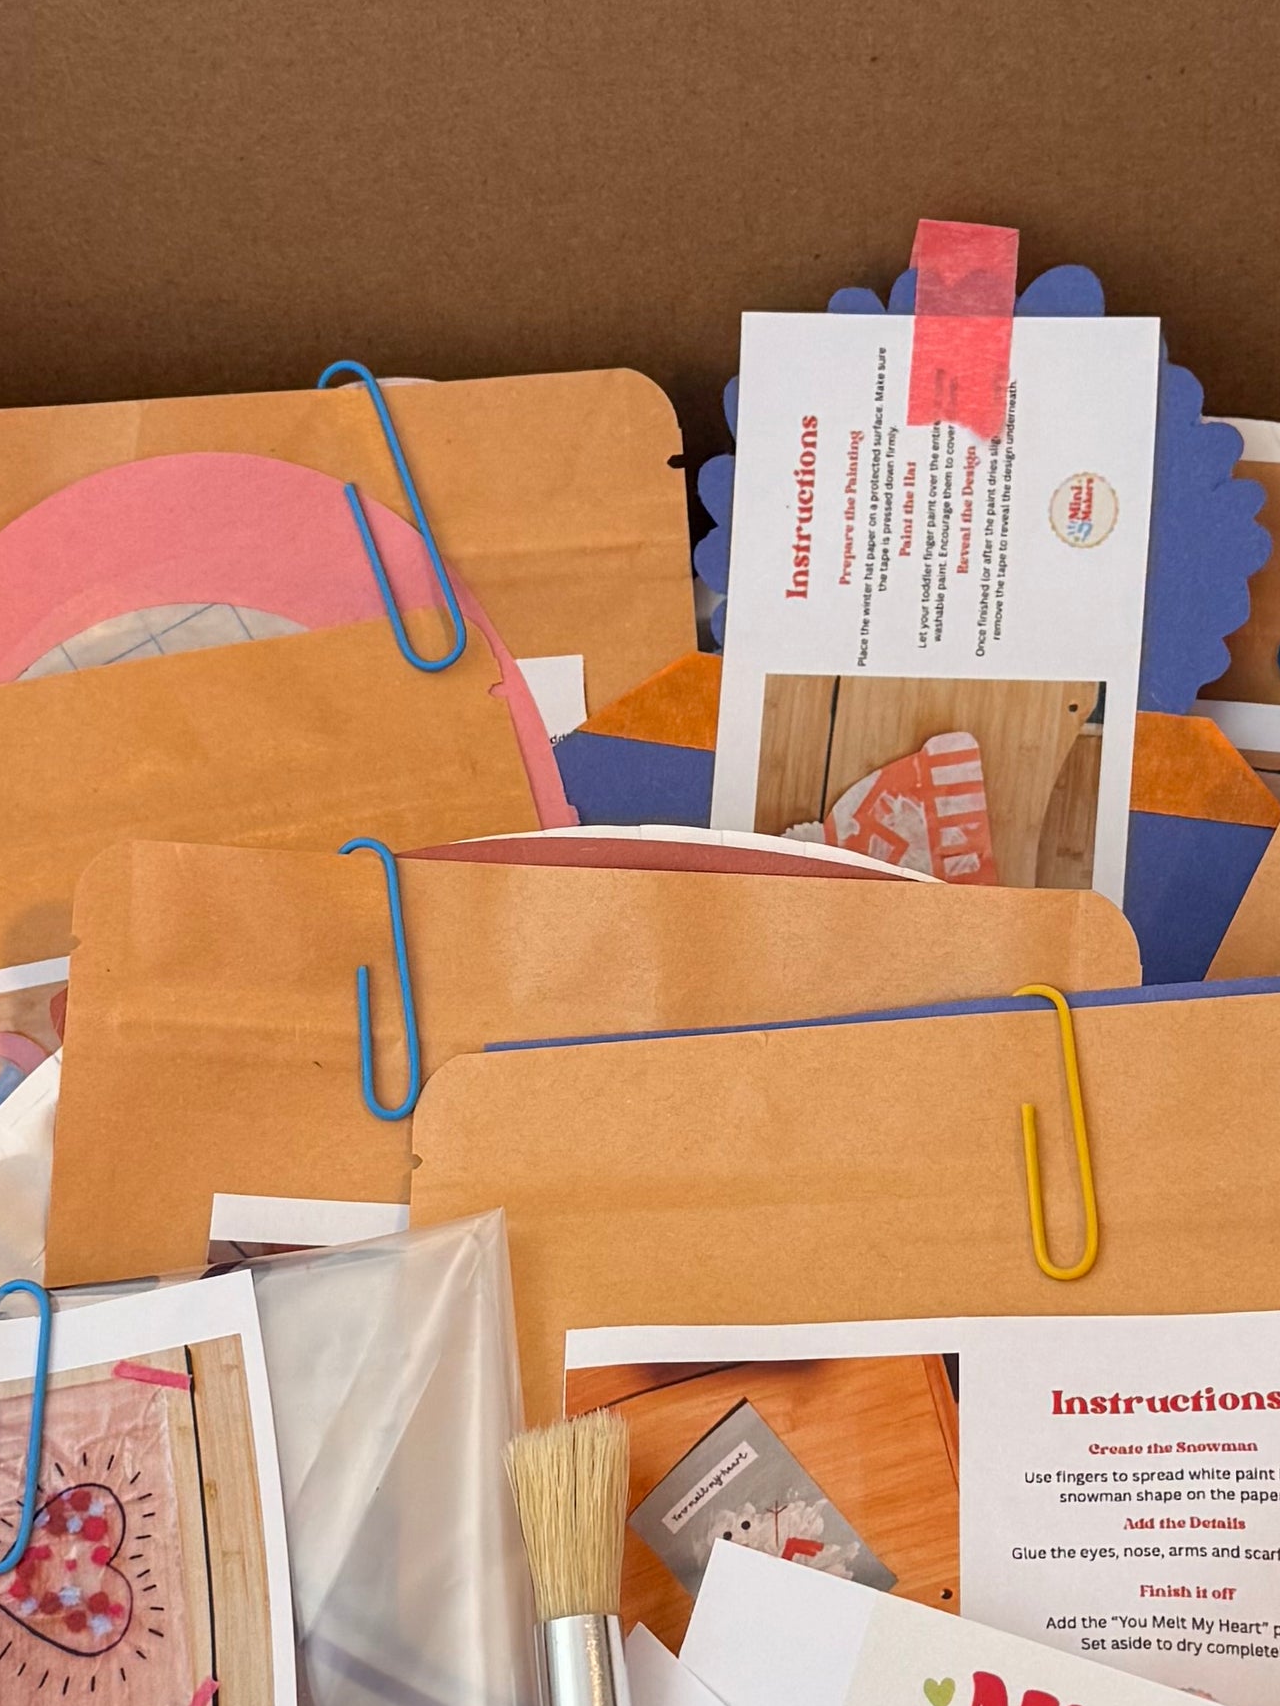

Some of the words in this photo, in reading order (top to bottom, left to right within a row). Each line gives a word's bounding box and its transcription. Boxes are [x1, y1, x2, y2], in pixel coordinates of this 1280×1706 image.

[885, 423, 899, 458] firmly.
[844, 430, 864, 494] Painting
[902, 461, 916, 487] Hat
[961, 445, 981, 496] Design
[883, 460, 894, 490] down
[785, 414, 818, 599] Instructions
[843, 496, 856, 520] the
[882, 491, 893, 534] pressed
[902, 490, 914, 514] the
[960, 499, 973, 523] the
[880, 536, 890, 545] is
[898, 518, 913, 556] Paint
[838, 524, 856, 585] Prepare
[879, 547, 890, 571] tape
[956, 526, 971, 573] Reveal
[877, 573, 887, 591] the
[1088, 1443, 1143, 1455] Create
[1146, 1442, 1173, 1454] the
[1175, 1441, 1258, 1453] Snowman
[1024, 1471, 1052, 1483] Use
[1055, 1470, 1108, 1485] fingers
[1112, 1471, 1128, 1482] to
[1132, 1468, 1184, 1485] spread
[1188, 1467, 1231, 1480] white
[1235, 1467, 1275, 1483] paint
[1059, 1491, 1132, 1503] snowman
[1136, 1489, 1182, 1504] shape
[1186, 1490, 1205, 1500] on
[1209, 1487, 1235, 1500] the
[1123, 1517, 1155, 1530] Add
[1159, 1517, 1186, 1529] the
[1189, 1516, 1246, 1530] Details
[1011, 1546, 1046, 1559] Glue
[1049, 1546, 1076, 1559] the
[1079, 1547, 1119, 1561] eyes,
[1123, 1546, 1165, 1559] nose,
[1168, 1546, 1207, 1557] arms
[1211, 1544, 1240, 1558] and
[1139, 1584, 1192, 1598] Finish
[1195, 1585, 1208, 1599] it
[1211, 1587, 1237, 1600] off
[1045, 1615, 1076, 1629] Add
[1080, 1615, 1107, 1629] the
[1152, 1615, 1187, 1629] Melt
[1191, 1616, 1214, 1635] My
[1081, 1637, 1107, 1650] Set
[1110, 1636, 1152, 1650] aside
[1156, 1638, 1172, 1651] to
[1176, 1637, 1203, 1656] dry
